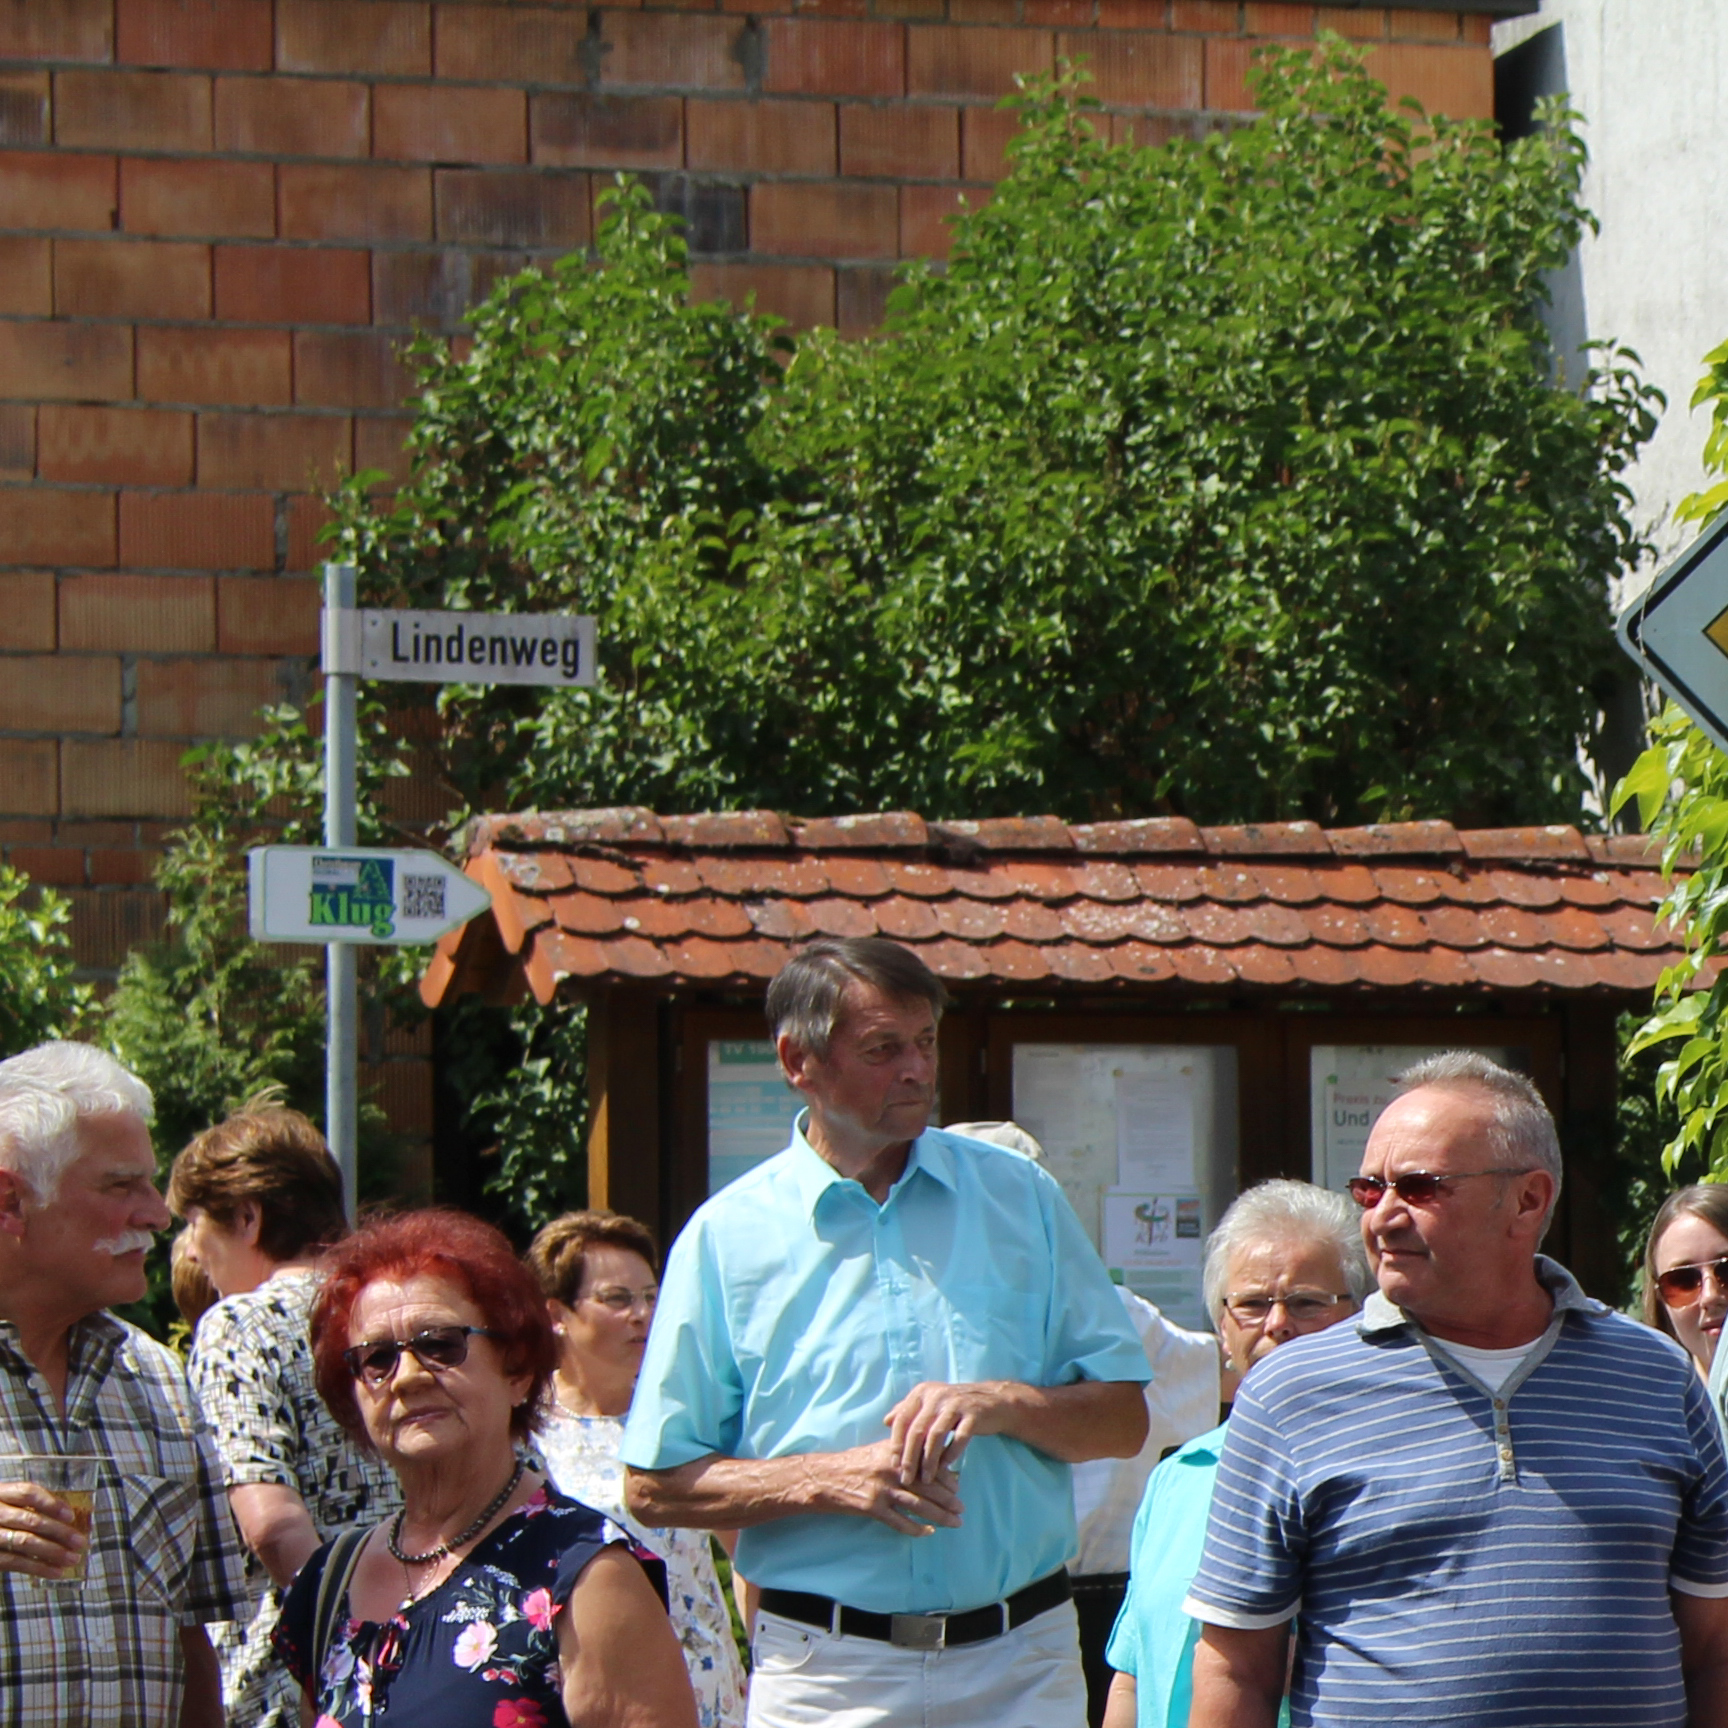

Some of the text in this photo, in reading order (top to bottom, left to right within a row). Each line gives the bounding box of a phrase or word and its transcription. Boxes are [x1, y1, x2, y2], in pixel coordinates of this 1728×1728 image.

[392, 622, 580, 679] Lindenweg
[309, 891, 396, 938] Klug
[1333, 1109, 1371, 1127] Und
